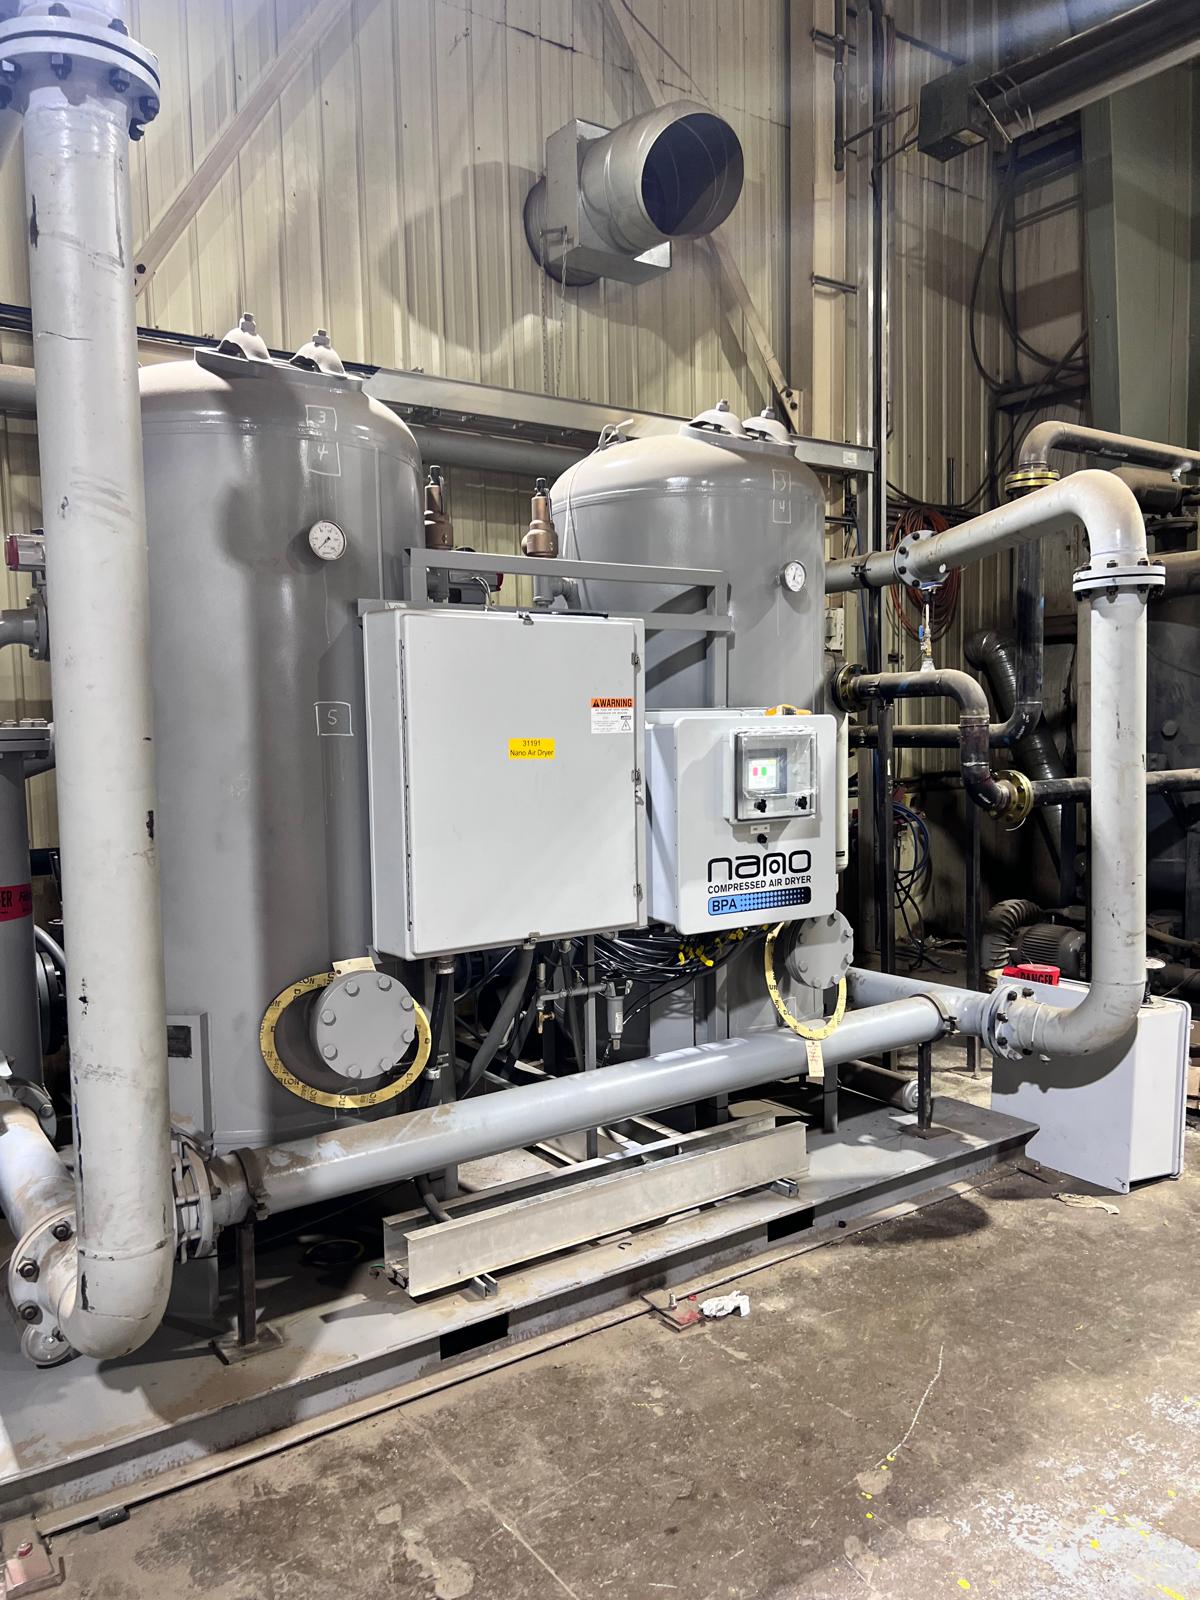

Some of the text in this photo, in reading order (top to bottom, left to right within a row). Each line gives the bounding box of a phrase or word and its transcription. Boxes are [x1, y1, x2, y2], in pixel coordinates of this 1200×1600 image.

[319, 410, 326, 424] 3
[317, 443, 329, 460] 4
[600, 698, 632, 708] WARNING
[522, 739, 541, 747] 31191
[537, 749, 554, 757] Dryer
[708, 875, 812, 894] COMPRESSED AIR DRYER
[712, 899, 737, 912] BPA
